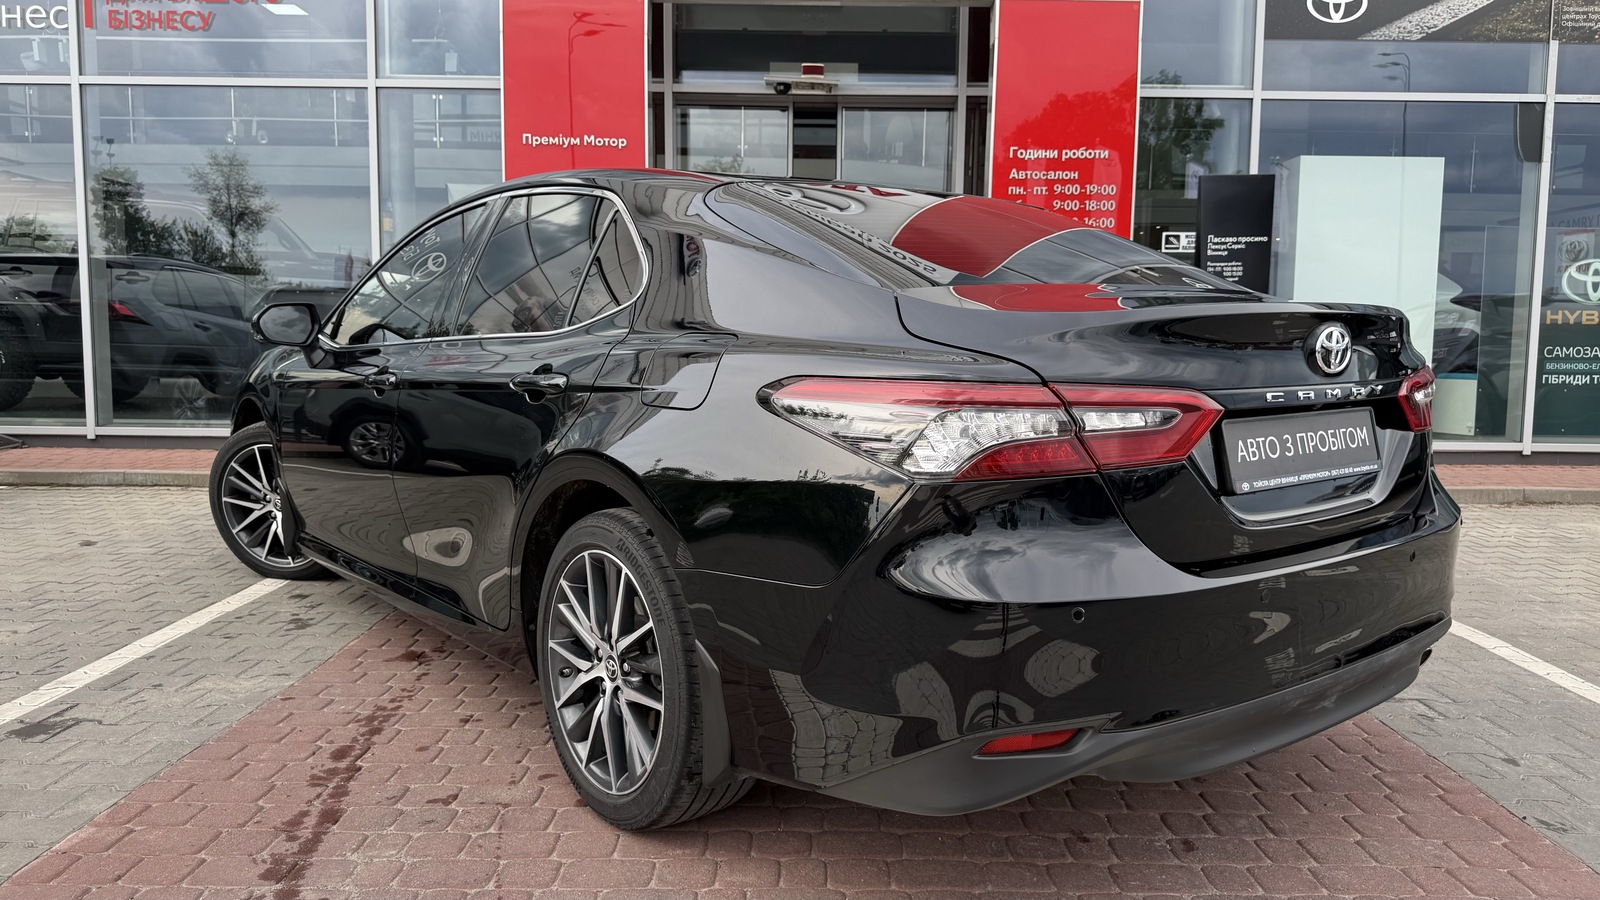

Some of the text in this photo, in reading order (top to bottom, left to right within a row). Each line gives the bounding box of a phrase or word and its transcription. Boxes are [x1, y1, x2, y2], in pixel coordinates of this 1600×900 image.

[108, 9, 213, 30] БІЗНЕСУ
[522, 133, 627, 149] Преміум Мотор
[1009, 146, 1109, 161] Години роботи
[1009, 168, 1079, 180] Автосалон
[1053, 184, 1117, 196] 9:00-19:00
[1053, 200, 1116, 211] 9:00-18:00
[1207, 235, 1237, 243] Ласкаво
[1545, 310, 1600, 325] HYB
[1544, 346, 1600, 358] САМОЗА
[1542, 374, 1590, 385] ГІБРИДИ
[1266, 385, 1383, 402] CAMRY
[1237, 435, 1280, 463] АВТО
[1296, 426, 1370, 455] ПРОБІГОМ
[616, 538, 666, 627] BRIDGESTONE
